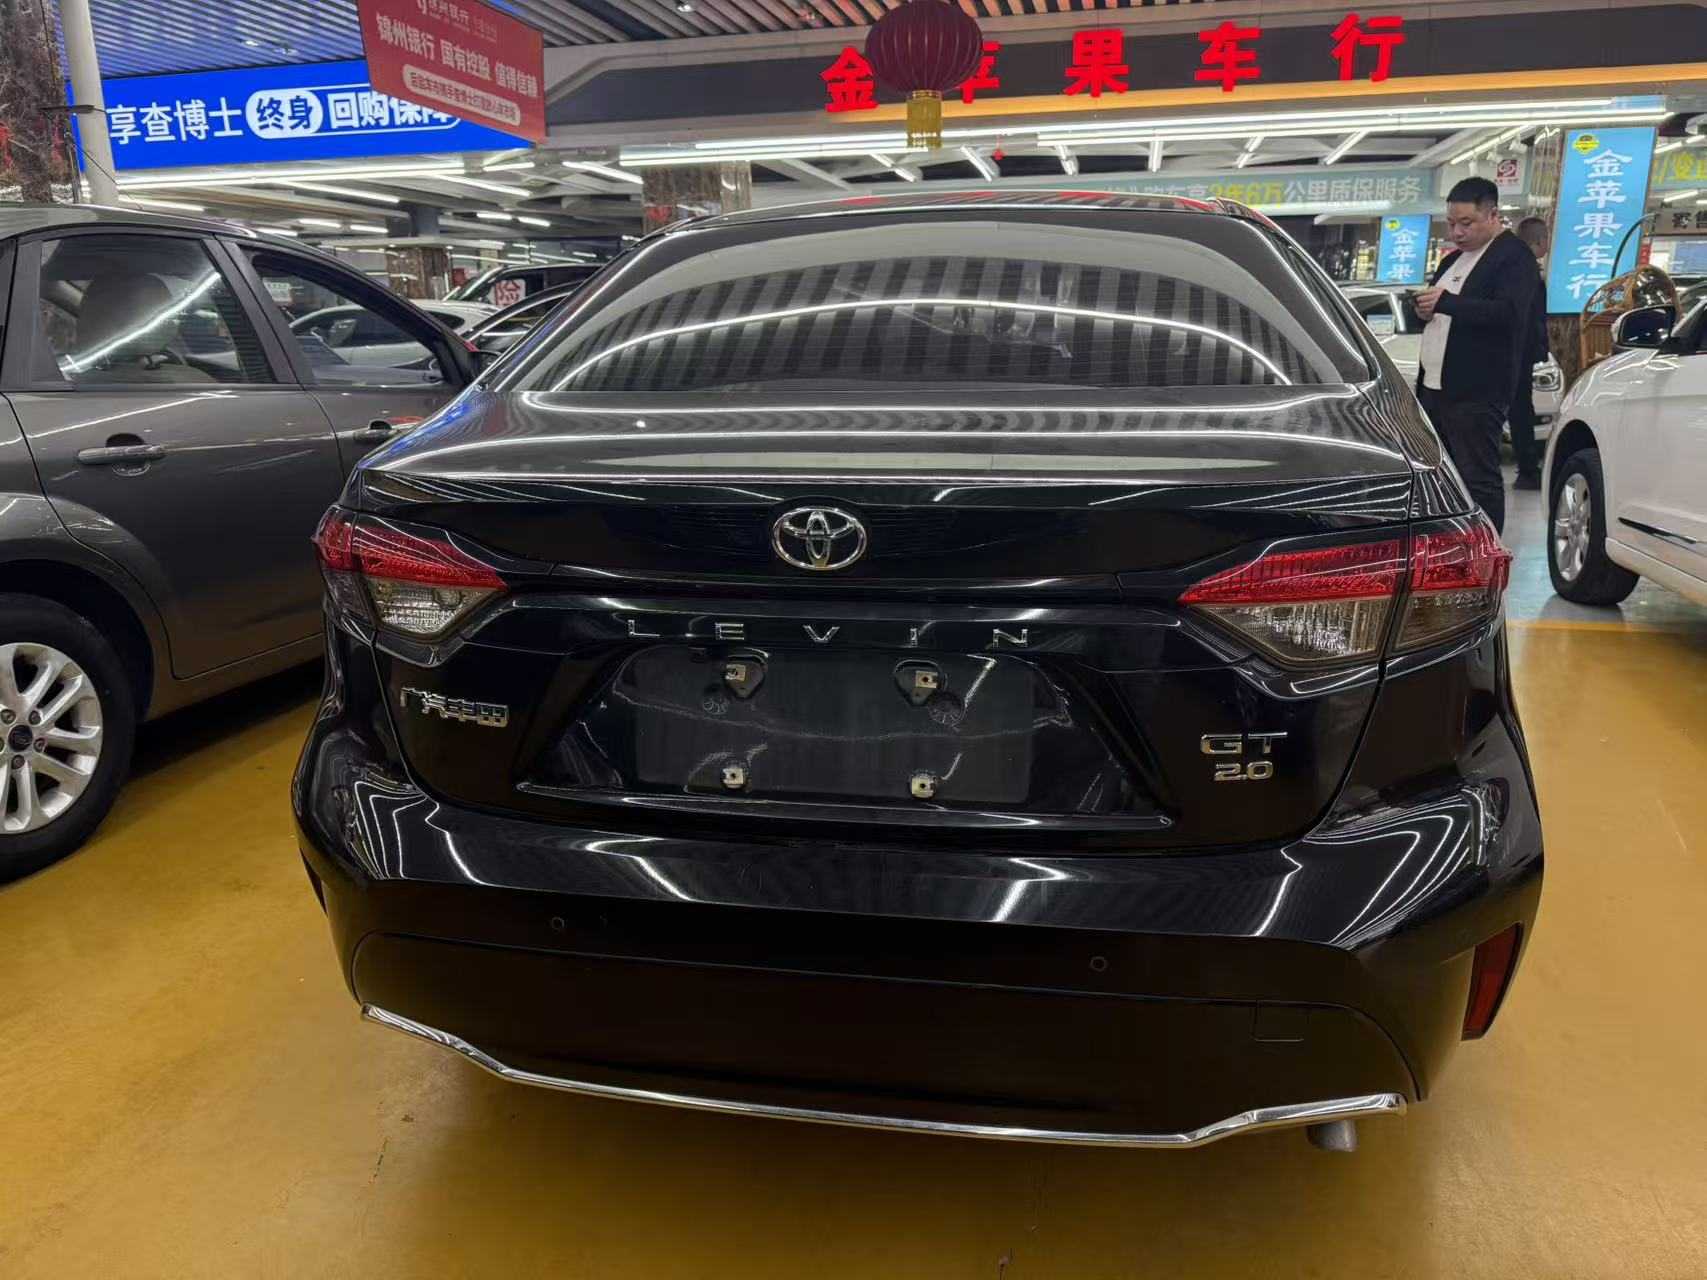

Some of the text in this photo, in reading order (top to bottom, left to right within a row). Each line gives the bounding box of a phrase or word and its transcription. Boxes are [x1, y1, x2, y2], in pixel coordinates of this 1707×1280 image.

[376, 11, 435, 60] 锦州银行
[106, 97, 243, 145] 享查博士
[256, 95, 313, 131] 终身
[1564, 149, 1634, 300] 金苹果车行
[627, 619, 1029, 649] LEVIN
[1200, 731, 1288, 755] GT
[1214, 760, 1274, 781] 2.0
